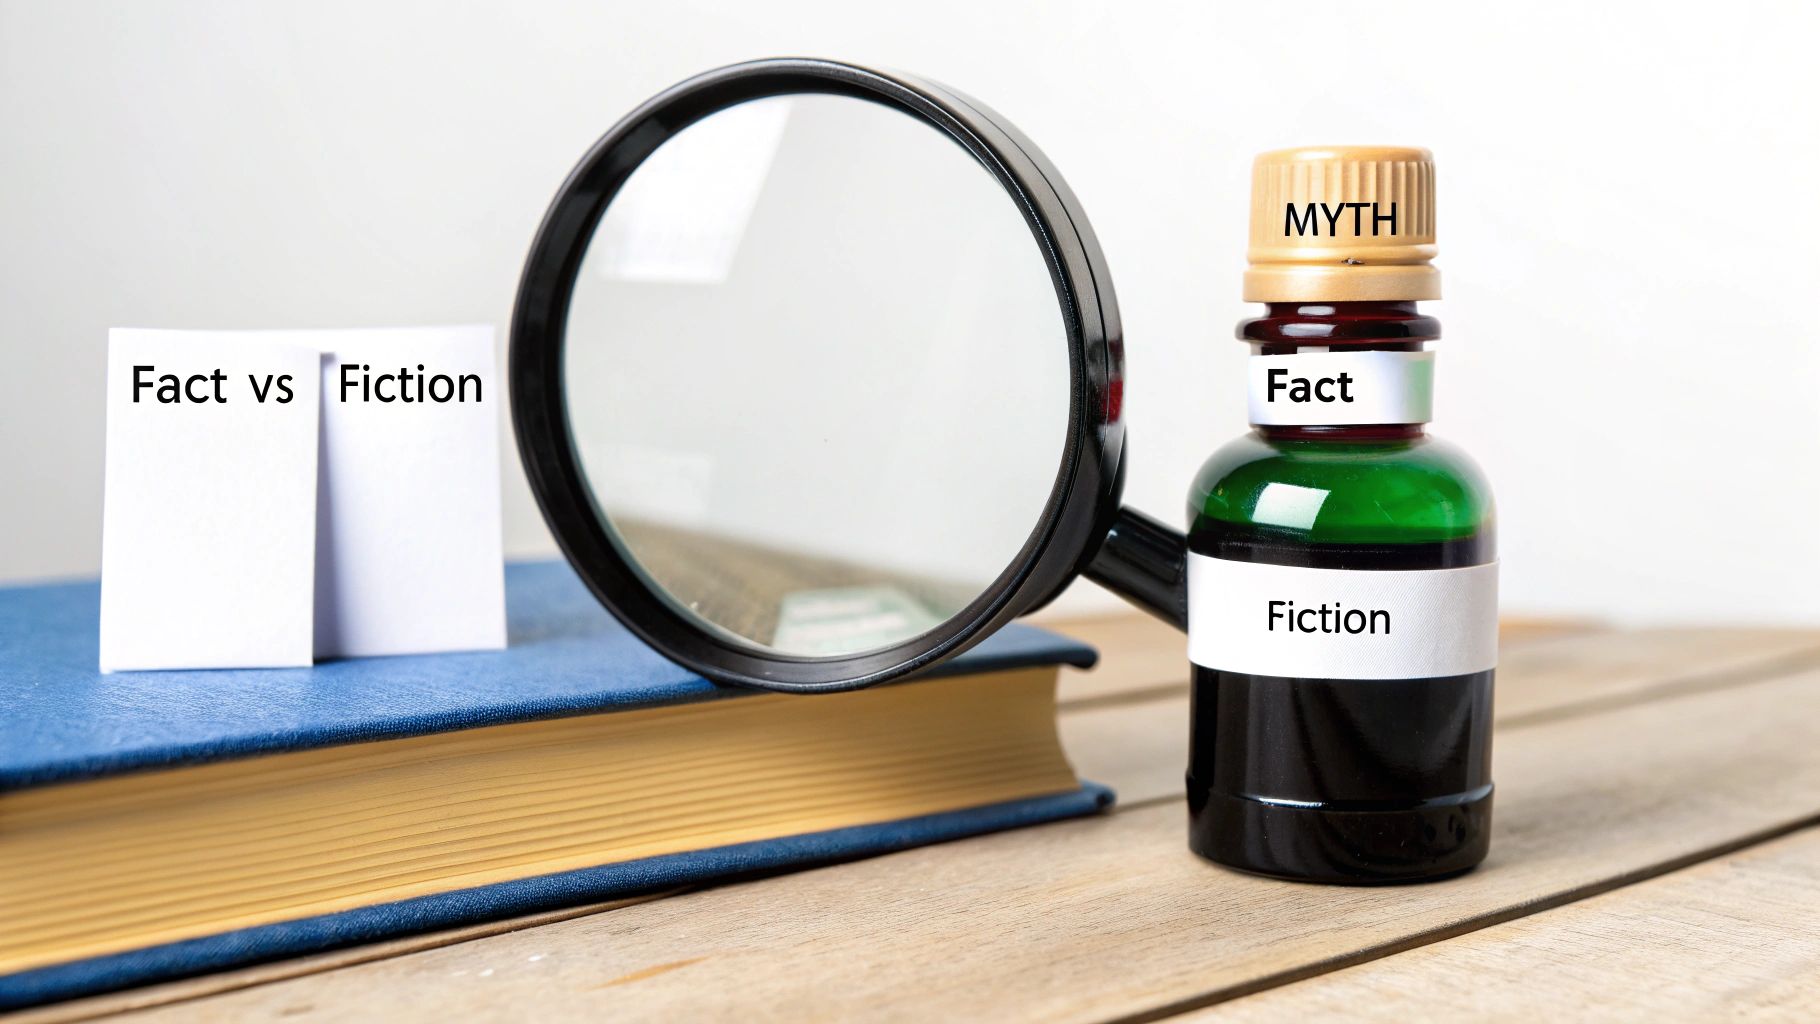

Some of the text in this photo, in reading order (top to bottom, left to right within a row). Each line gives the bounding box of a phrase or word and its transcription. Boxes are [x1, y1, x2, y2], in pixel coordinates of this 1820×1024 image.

[1284, 202, 1397, 237] MYTH
[133, 363, 482, 404] Fact vs Fiction
[1267, 368, 1354, 403] Fact
[1268, 600, 1391, 635] Fiction
